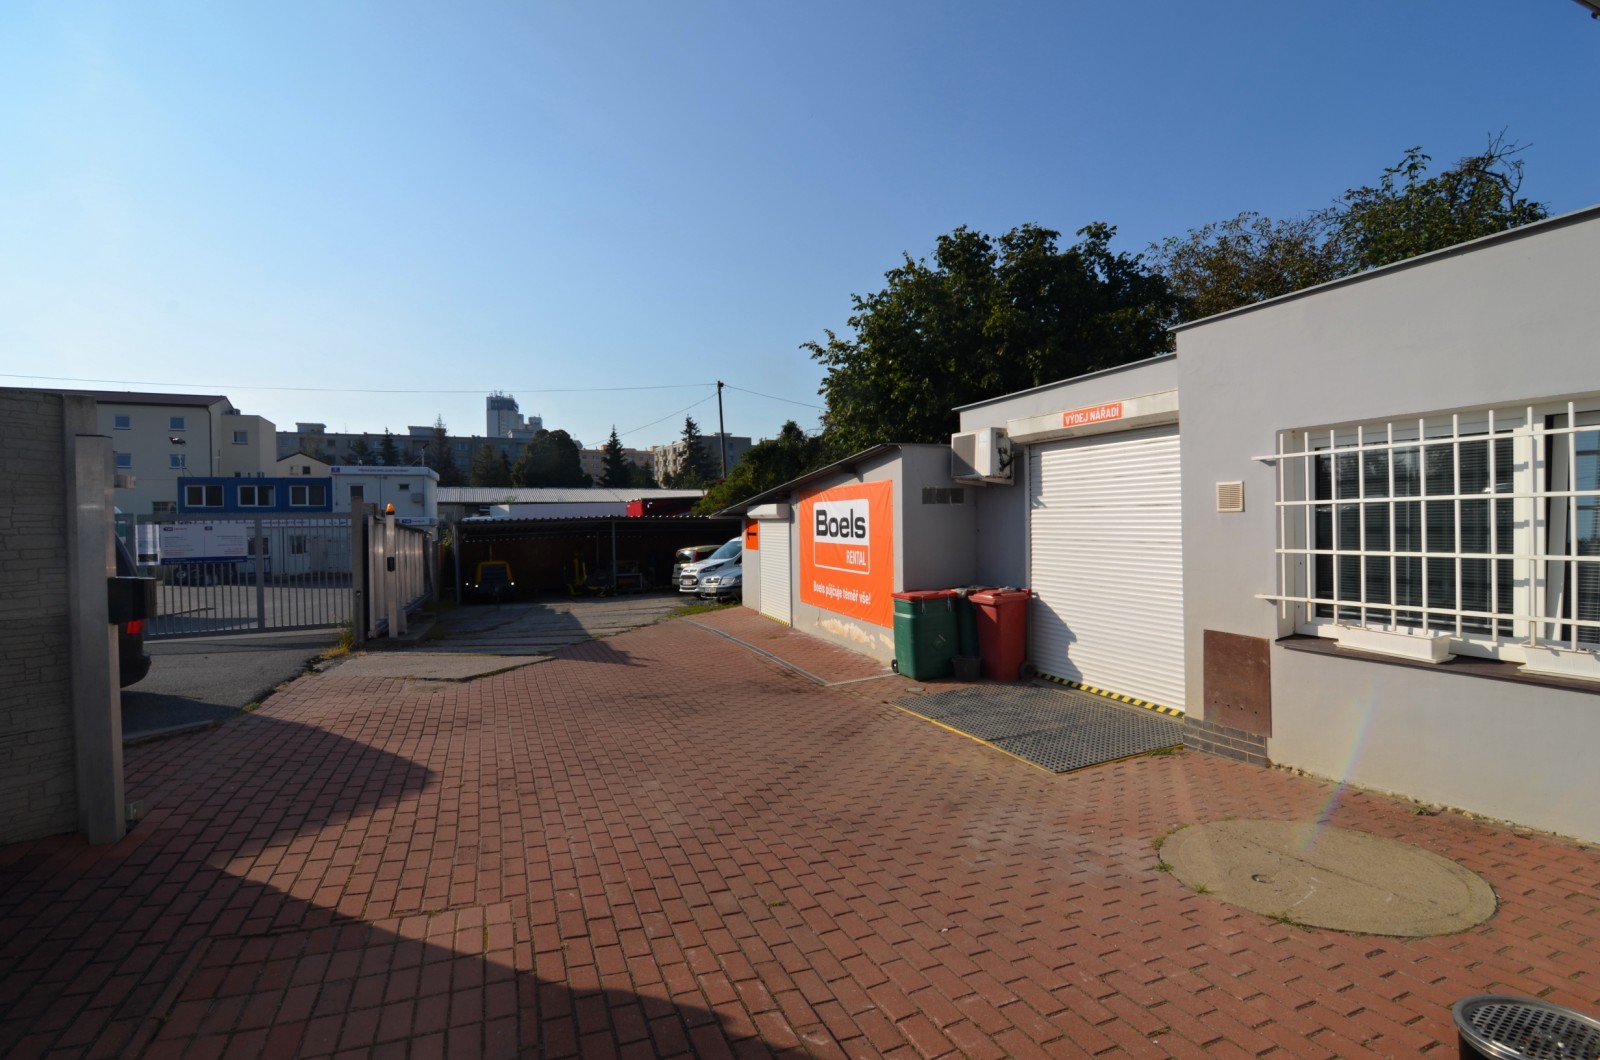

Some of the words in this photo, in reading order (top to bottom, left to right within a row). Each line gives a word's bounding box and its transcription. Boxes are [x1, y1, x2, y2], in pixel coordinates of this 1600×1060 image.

[1065, 412, 1088, 425] VÝDEJ
[1090, 404, 1119, 420] NÁŘADÍ
[816, 508, 866, 538] Boels
[846, 550, 866, 566] RENTAL
[813, 580, 825, 594] Boels
[859, 591, 871, 605] vše!
